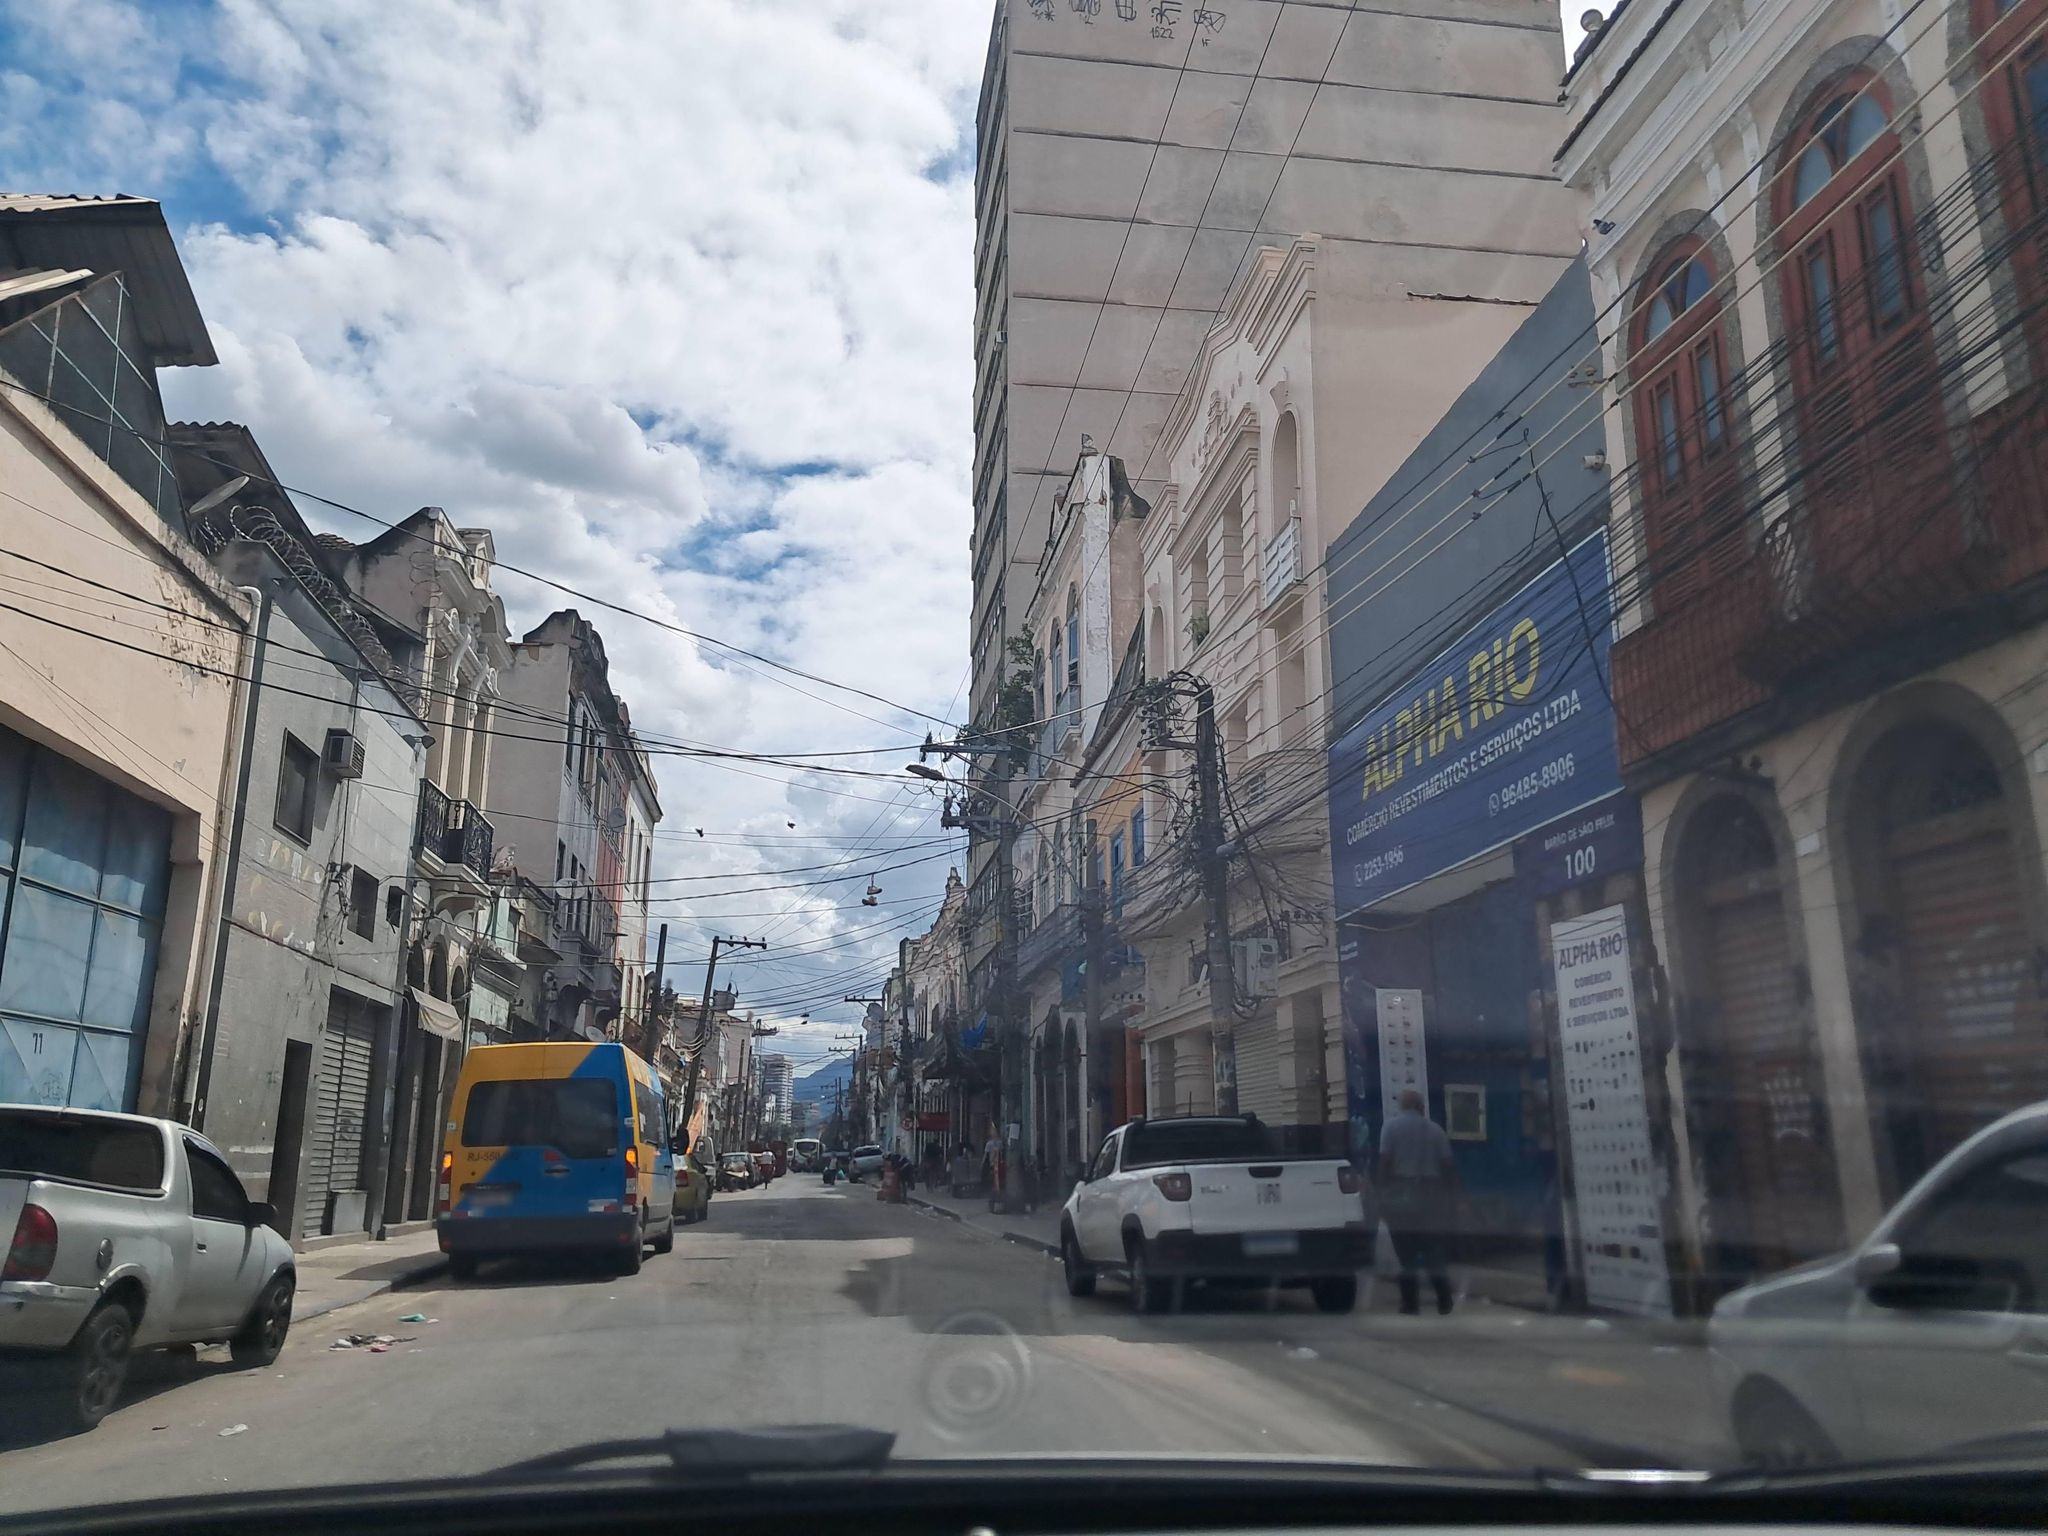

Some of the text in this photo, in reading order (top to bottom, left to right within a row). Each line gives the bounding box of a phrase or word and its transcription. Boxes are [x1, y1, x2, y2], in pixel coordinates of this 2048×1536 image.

[1363, 617, 1540, 801] ALPHA RIO
[1389, 757, 1468, 820] REVESTIMENTOS
[1470, 750, 1479, 772] E
[1480, 711, 1542, 767] SERVIÇOS
[1544, 689, 1581, 729] LTDA
[1501, 752, 1575, 809] 96485-8906
[1565, 845, 1595, 879] 100
[1559, 933, 1622, 970] ALPHA RIO
